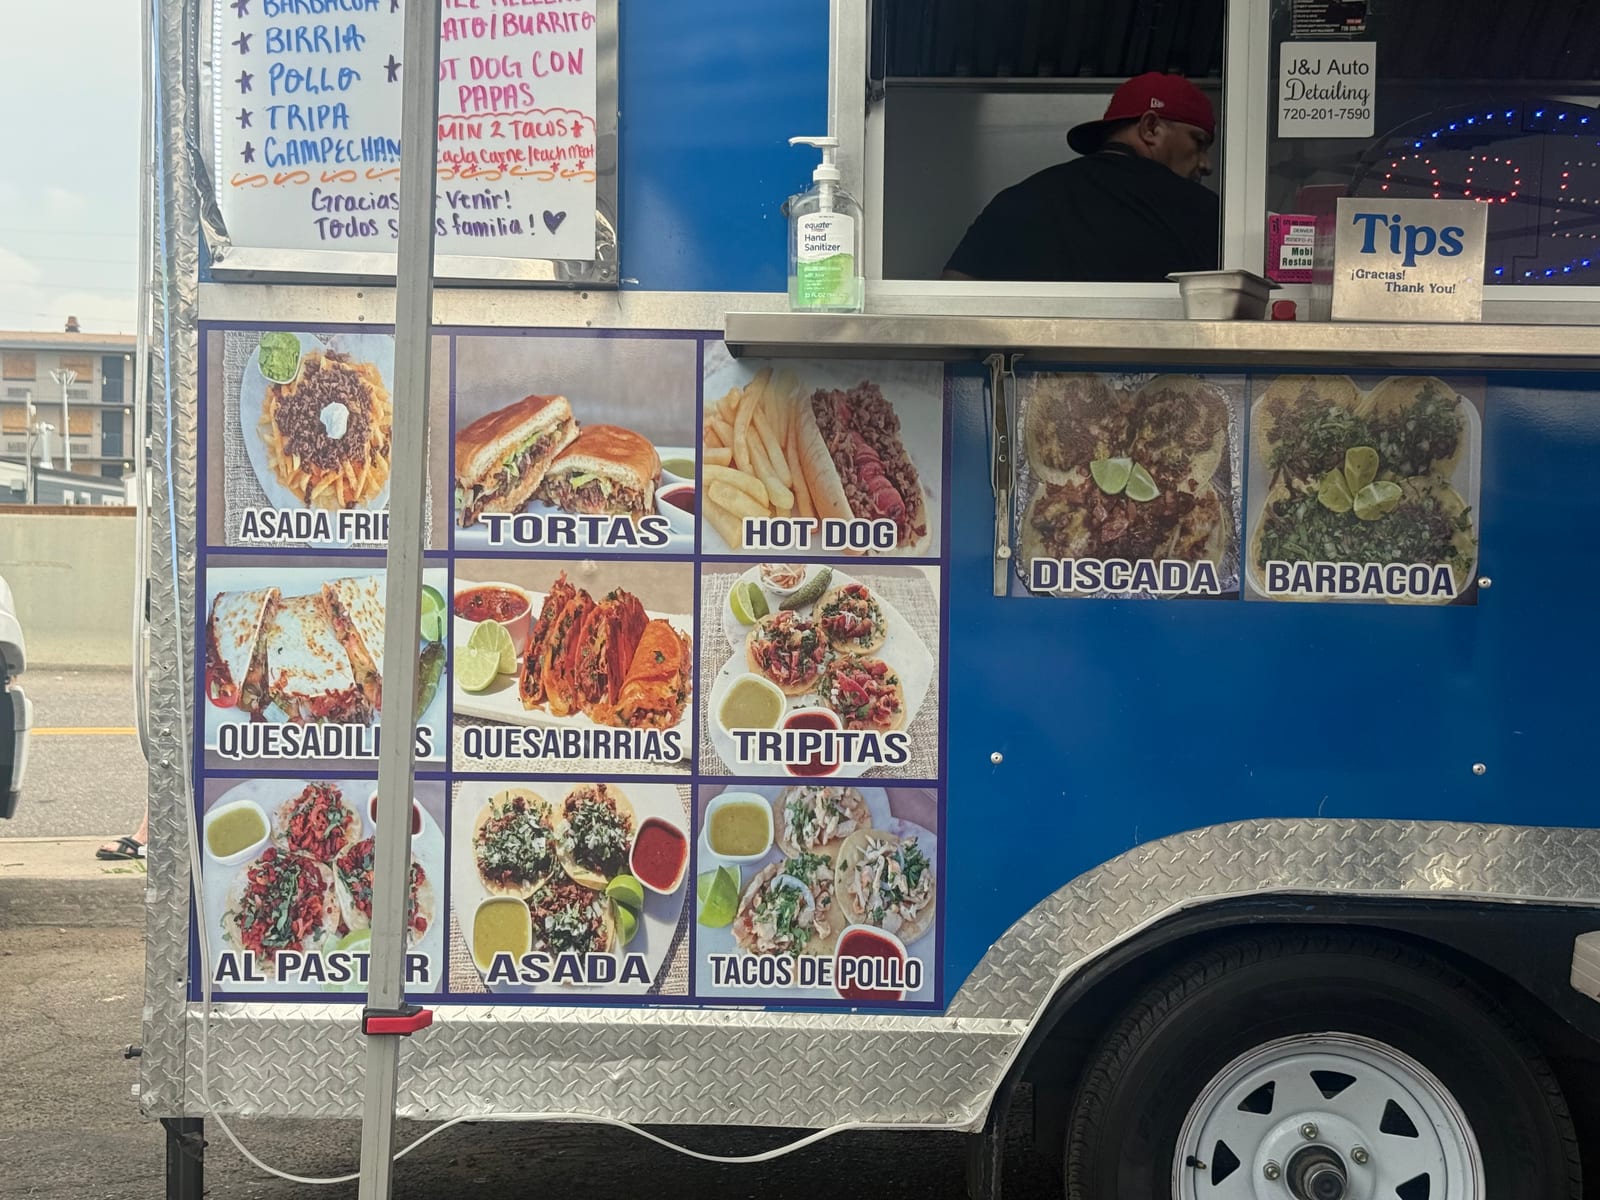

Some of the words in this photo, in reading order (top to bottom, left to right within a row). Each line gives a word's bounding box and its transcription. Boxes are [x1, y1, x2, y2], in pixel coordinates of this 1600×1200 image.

[266, 24, 366, 54] BIRRIA
[269, 62, 361, 96] POLLO
[470, 55, 522, 80] DOG
[532, 48, 583, 78] CON
[1287, 59, 1320, 76] J&J
[1327, 59, 1369, 75] Auto
[458, 82, 535, 113] PAPAS
[1284, 78, 1370, 105] Detailing
[265, 103, 350, 132] TRIPA
[1283, 108, 1370, 121] 720-201-7590
[439, 122, 482, 142] MIN
[490, 120, 506, 139] 2
[264, 136, 400, 168] CAMPECHAN
[437, 146, 479, 165] ada
[311, 187, 399, 213] Gracias
[313, 215, 379, 241] Todos
[804, 222, 830, 230] equate
[804, 233, 827, 242] Hand
[1353, 213, 1464, 267] Tips
[804, 243, 841, 252] Sanitizer
[1282, 257, 1312, 266] Restau
[1291, 247, 1313, 257] Mobi
[1351, 268, 1406, 281] ¡Gracias!
[1385, 282, 1424, 294] Thank
[1429, 283, 1456, 294] You!
[241, 510, 331, 540] ASADA
[339, 512, 389, 541] FRI
[481, 515, 669, 547] TORTAS
[746, 519, 816, 548] HOT
[826, 520, 895, 549] DOG
[1033, 560, 1219, 592] DISCADA
[1268, 563, 1456, 597] BARBACOA
[218, 724, 432, 758] QUESADILS
[464, 728, 682, 762] QUESABIRRIAS
[733, 731, 908, 763] TRIPITAS
[215, 953, 264, 982] AL
[278, 953, 429, 983] PASTR
[487, 953, 651, 984] ASADA
[710, 957, 792, 986] TACOS
[801, 957, 831, 986] DE
[840, 958, 921, 988] POLLO
